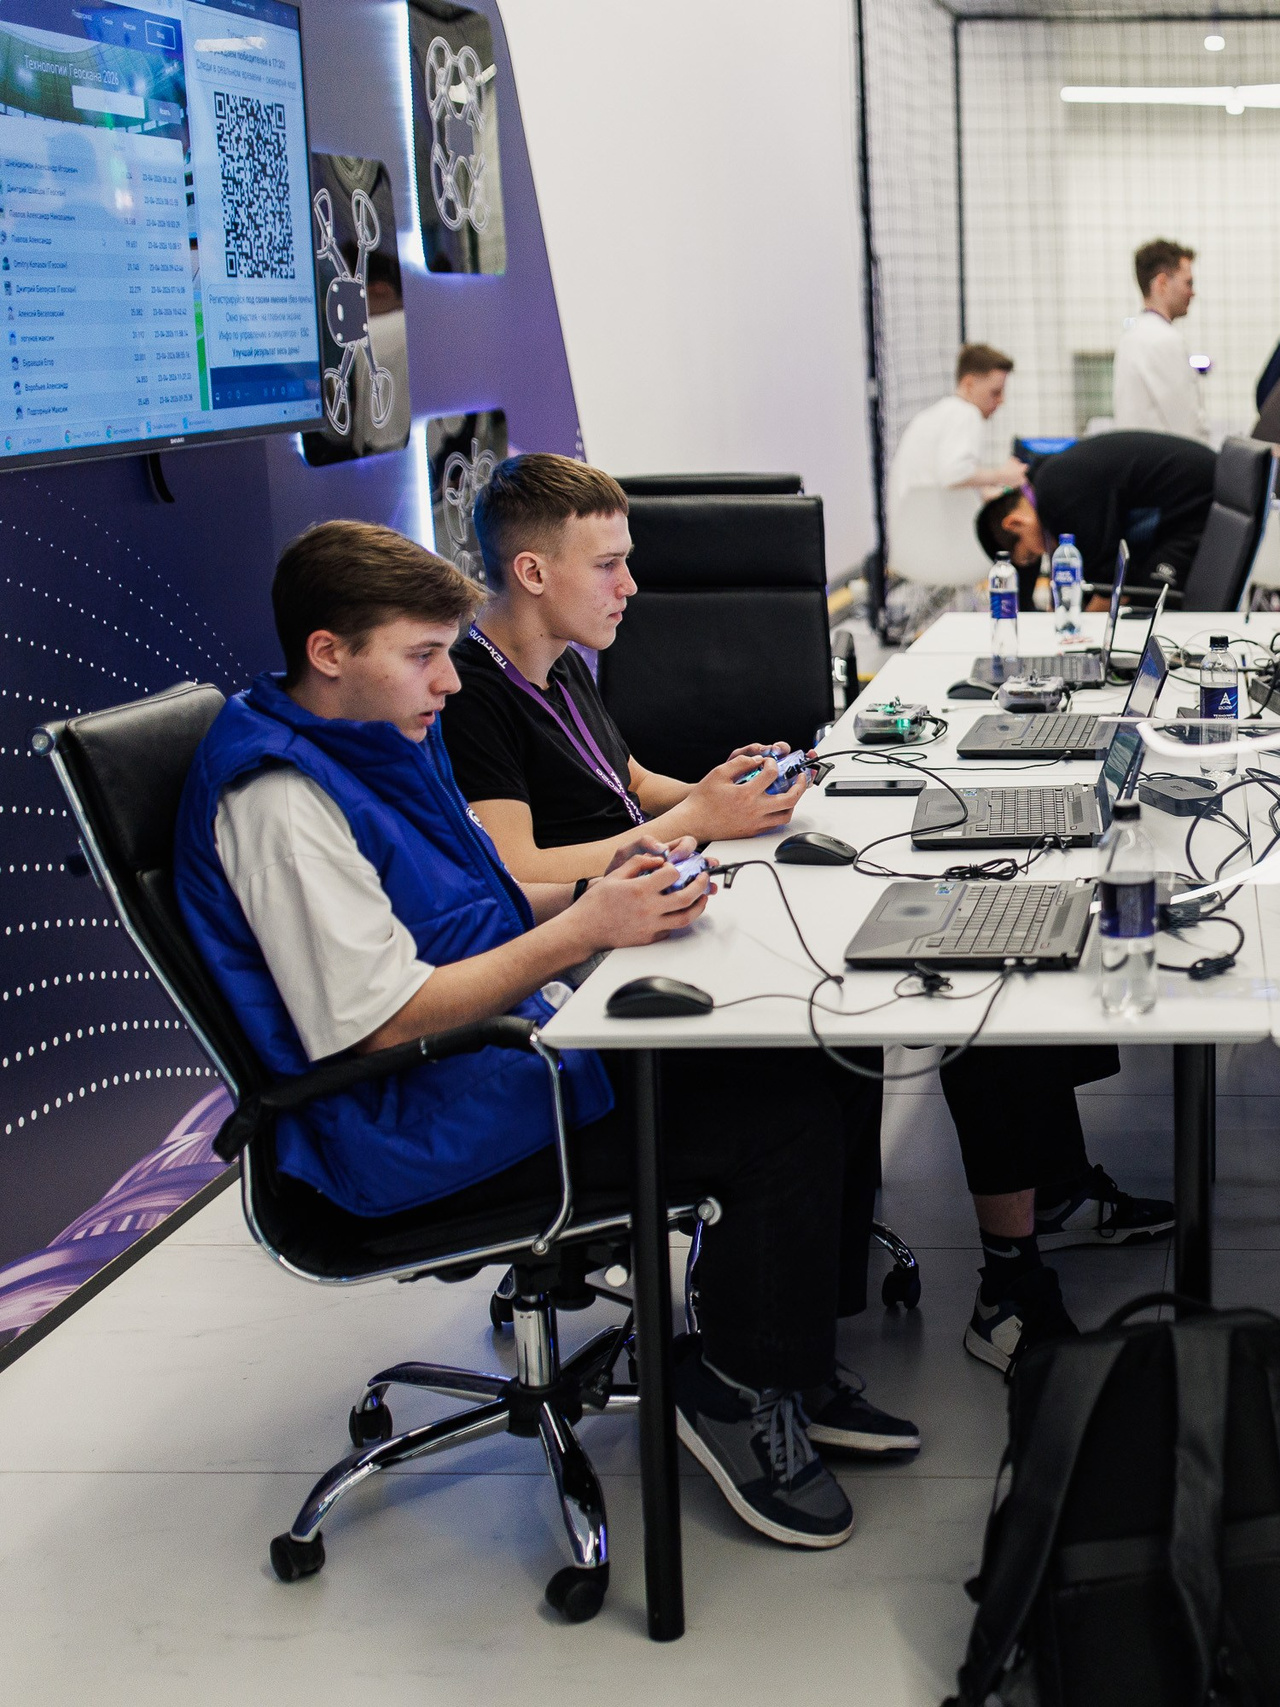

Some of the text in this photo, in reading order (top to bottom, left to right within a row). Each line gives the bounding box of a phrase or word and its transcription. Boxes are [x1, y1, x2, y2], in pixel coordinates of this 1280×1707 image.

[24, 54, 119, 86] Технологии Геоскана 2026
[470, 628, 507, 670] ТЕХНОЛО
